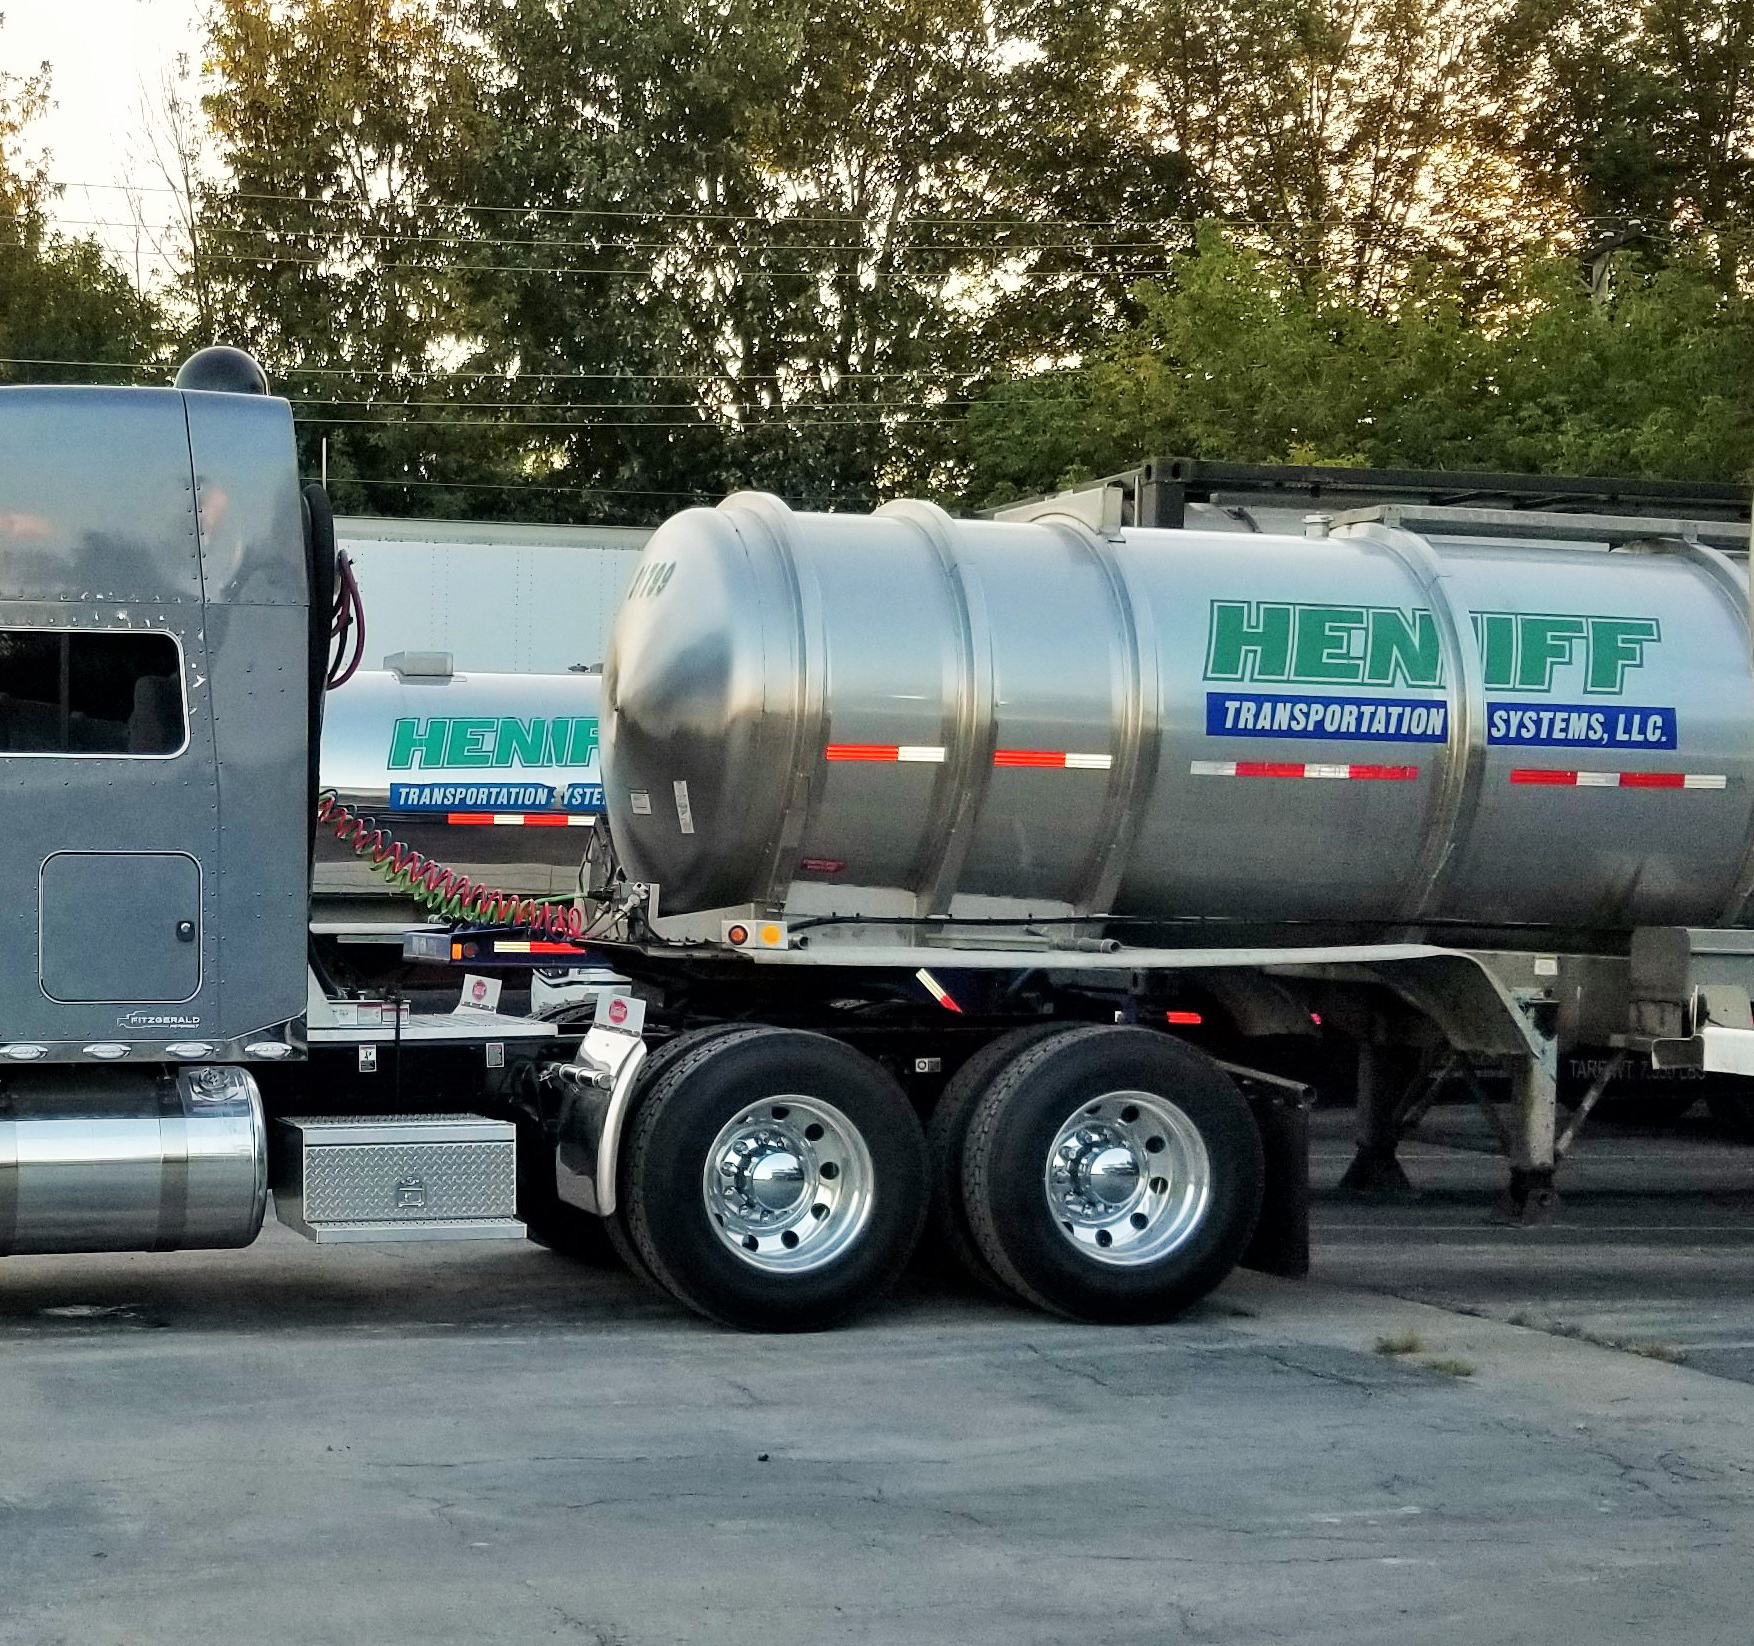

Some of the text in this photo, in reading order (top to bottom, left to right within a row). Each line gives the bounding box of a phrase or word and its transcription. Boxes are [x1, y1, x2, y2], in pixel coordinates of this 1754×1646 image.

[1203, 599, 1661, 695] HENIFF
[1224, 700, 1667, 745] TRANSPORTATION SYSTEMS, LLC.
[398, 787, 549, 806] TRANSPORTATION
[131, 1016, 200, 1024] FITZGERALD
